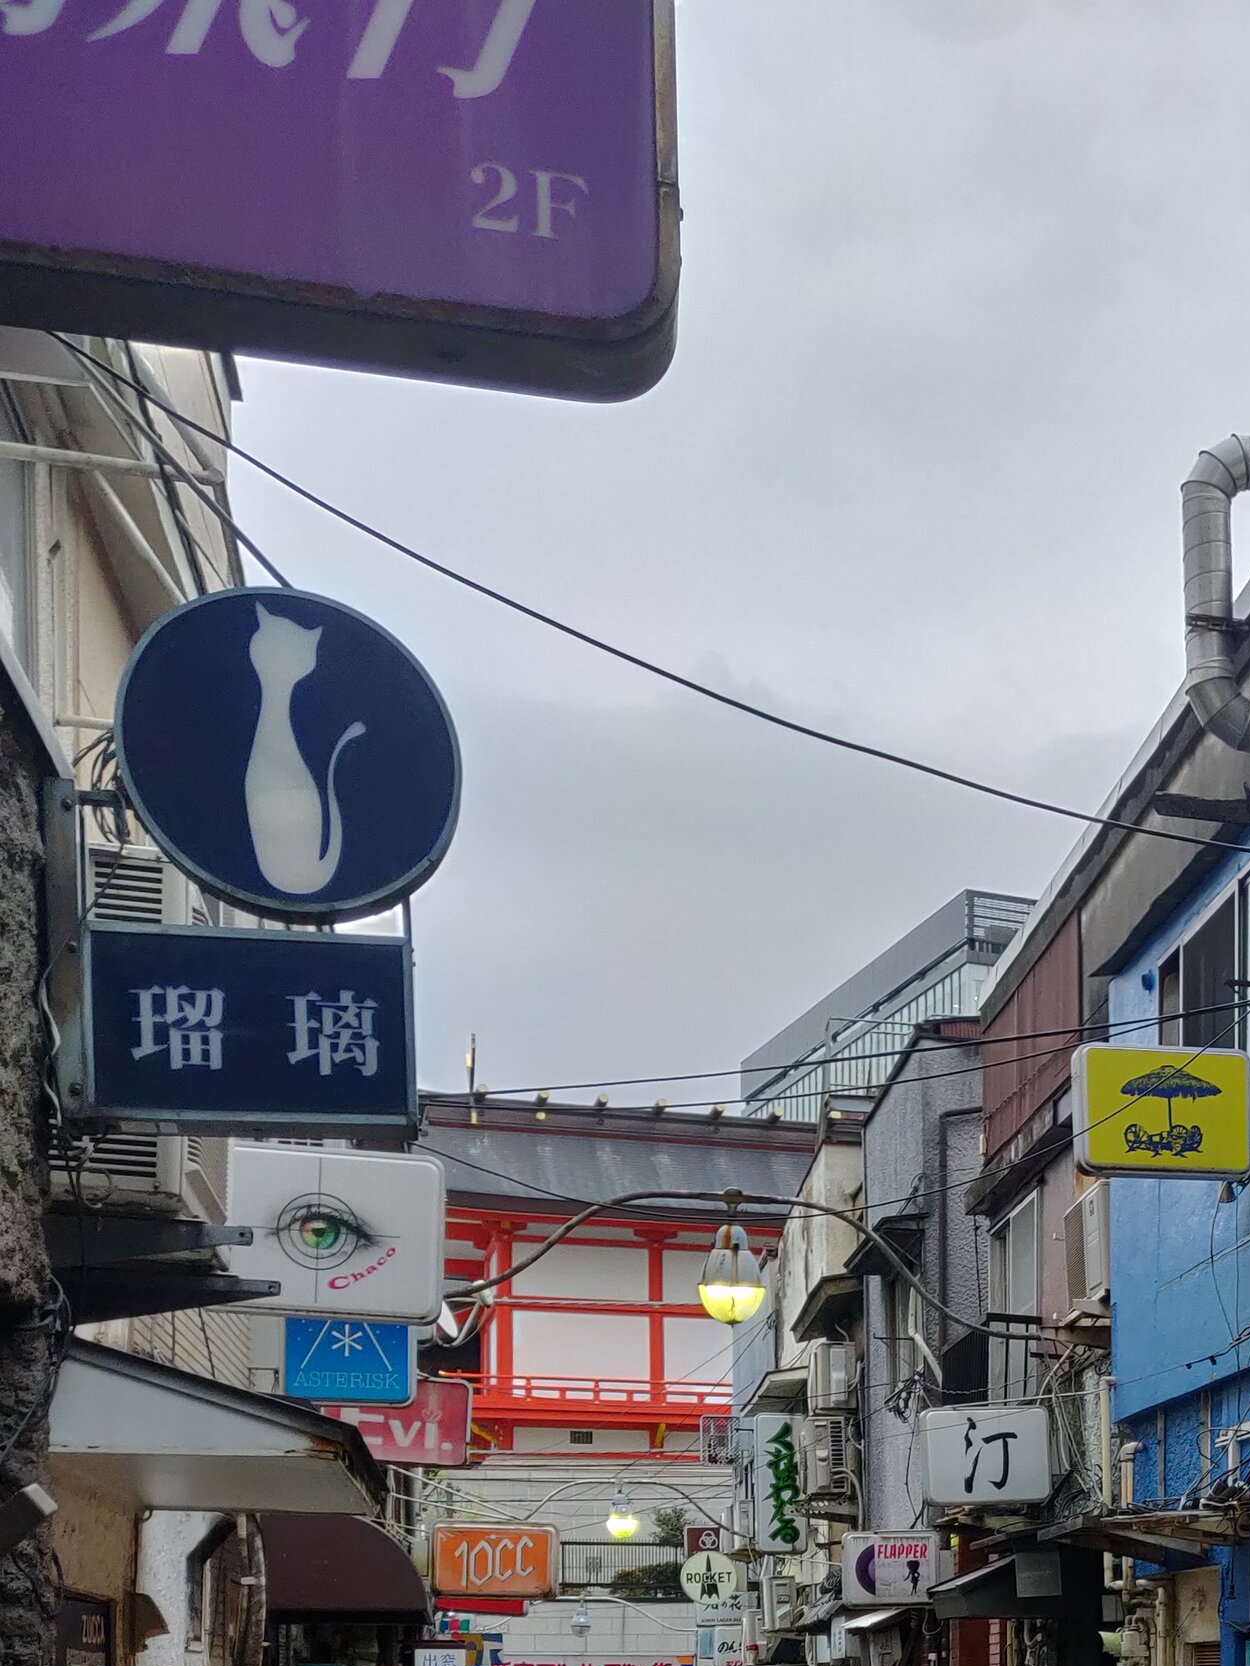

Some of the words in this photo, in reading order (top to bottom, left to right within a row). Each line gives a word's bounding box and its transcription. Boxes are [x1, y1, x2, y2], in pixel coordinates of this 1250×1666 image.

[470, 162, 589, 240] 2F
[128, 984, 379, 1076] 瑠璃
[327, 1247, 396, 1290] Chaco
[293, 1371, 400, 1389] ASTERISK
[877, 1543, 927, 1559] FLAPPER
[686, 1572, 732, 1584] ROCKET
